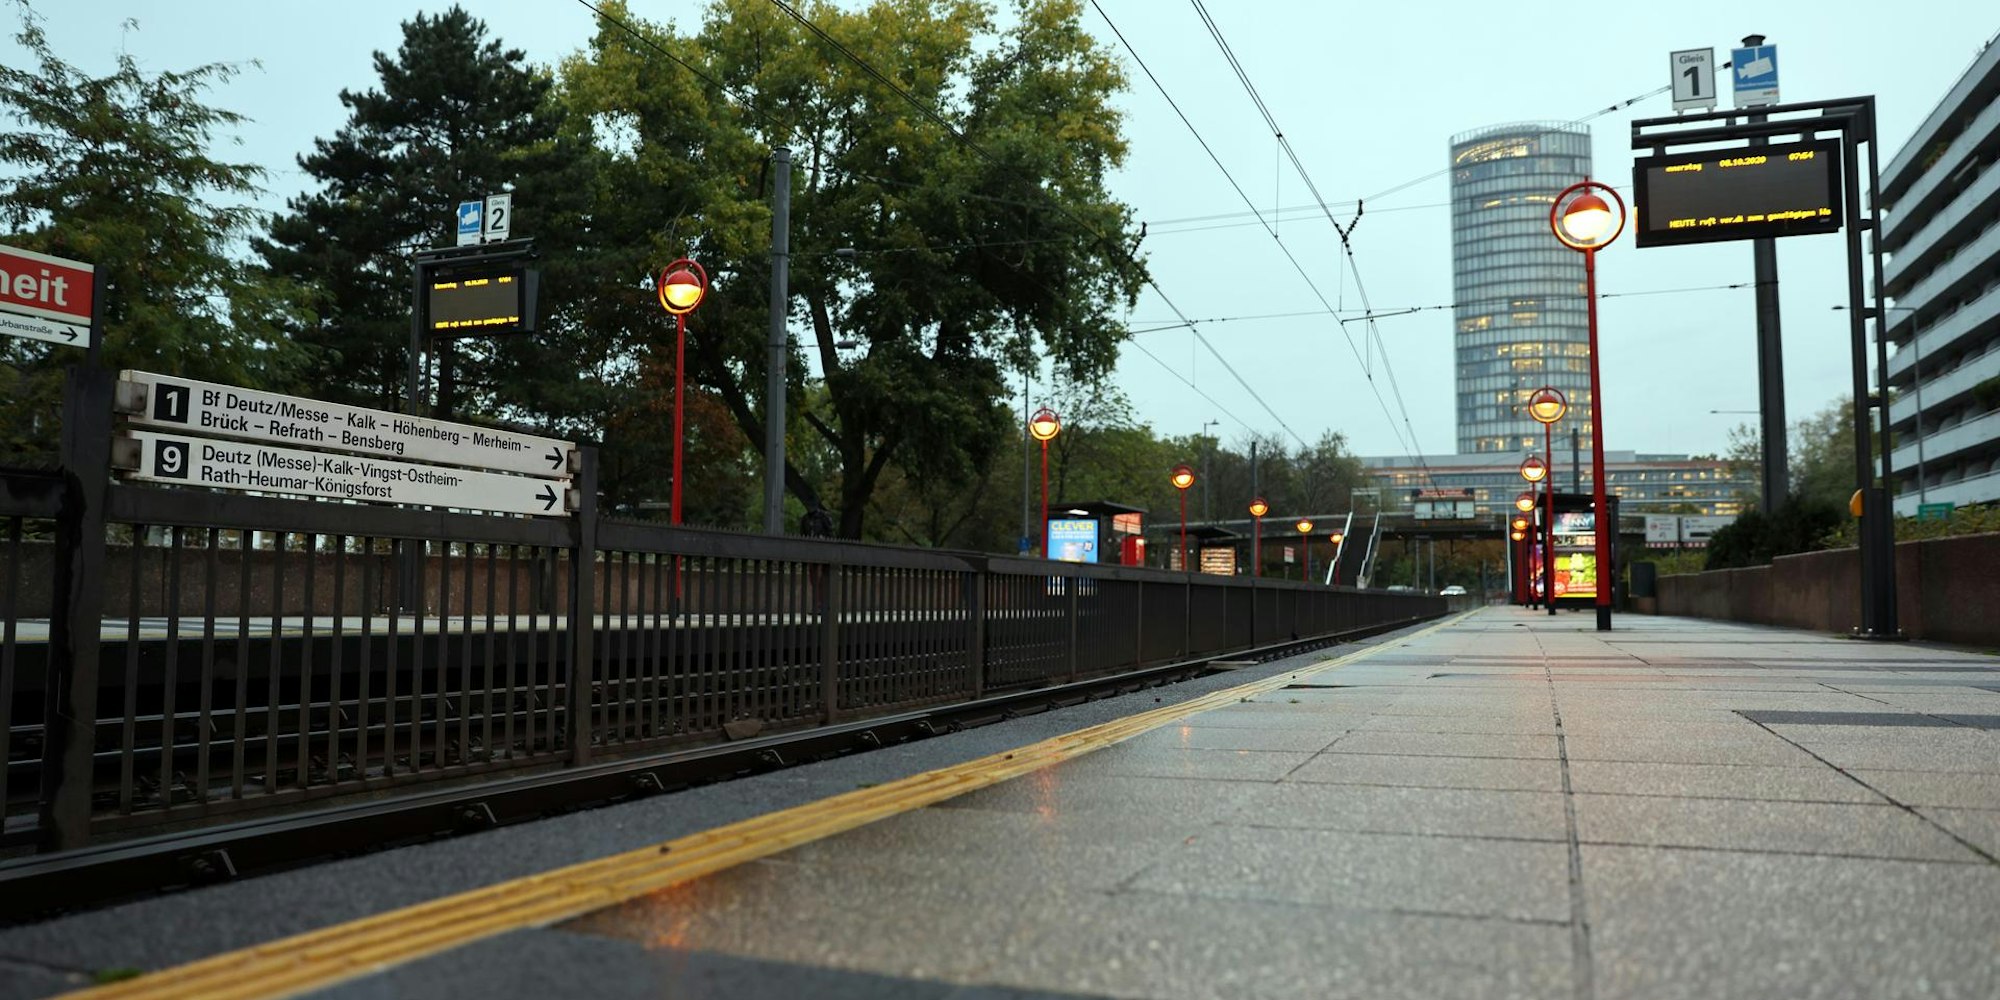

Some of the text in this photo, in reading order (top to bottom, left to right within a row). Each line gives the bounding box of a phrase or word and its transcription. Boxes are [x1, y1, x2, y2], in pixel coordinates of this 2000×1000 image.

[1679, 54, 1705, 64] Gleis
[1683, 66, 1700, 96] 1
[1719, 156, 1767, 168] 08.10.2020
[1788, 151, 1814, 161] 07:54
[491, 208, 504, 230] 2
[1669, 218, 1697, 229] HEUTE
[165, 390, 179, 417] 1
[200, 411, 249, 432] Brück
[269, 420, 324, 441] Refrath
[342, 430, 405, 455] Bensberg
[202, 390, 221, 407] Bf
[226, 393, 329, 423] Deutz/Messe
[347, 412, 376, 430] Kalk
[393, 419, 460, 446] Höhenberg
[473, 432, 521, 452] Merheim
[162, 446, 182, 473] 9
[202, 445, 463, 487] Deutz (Messe)-Kalk-Vingst-Ostheim-
[201, 466, 393, 498] Rath-Heumar-Königsforst
[1051, 521, 1094, 531] CLEVER
